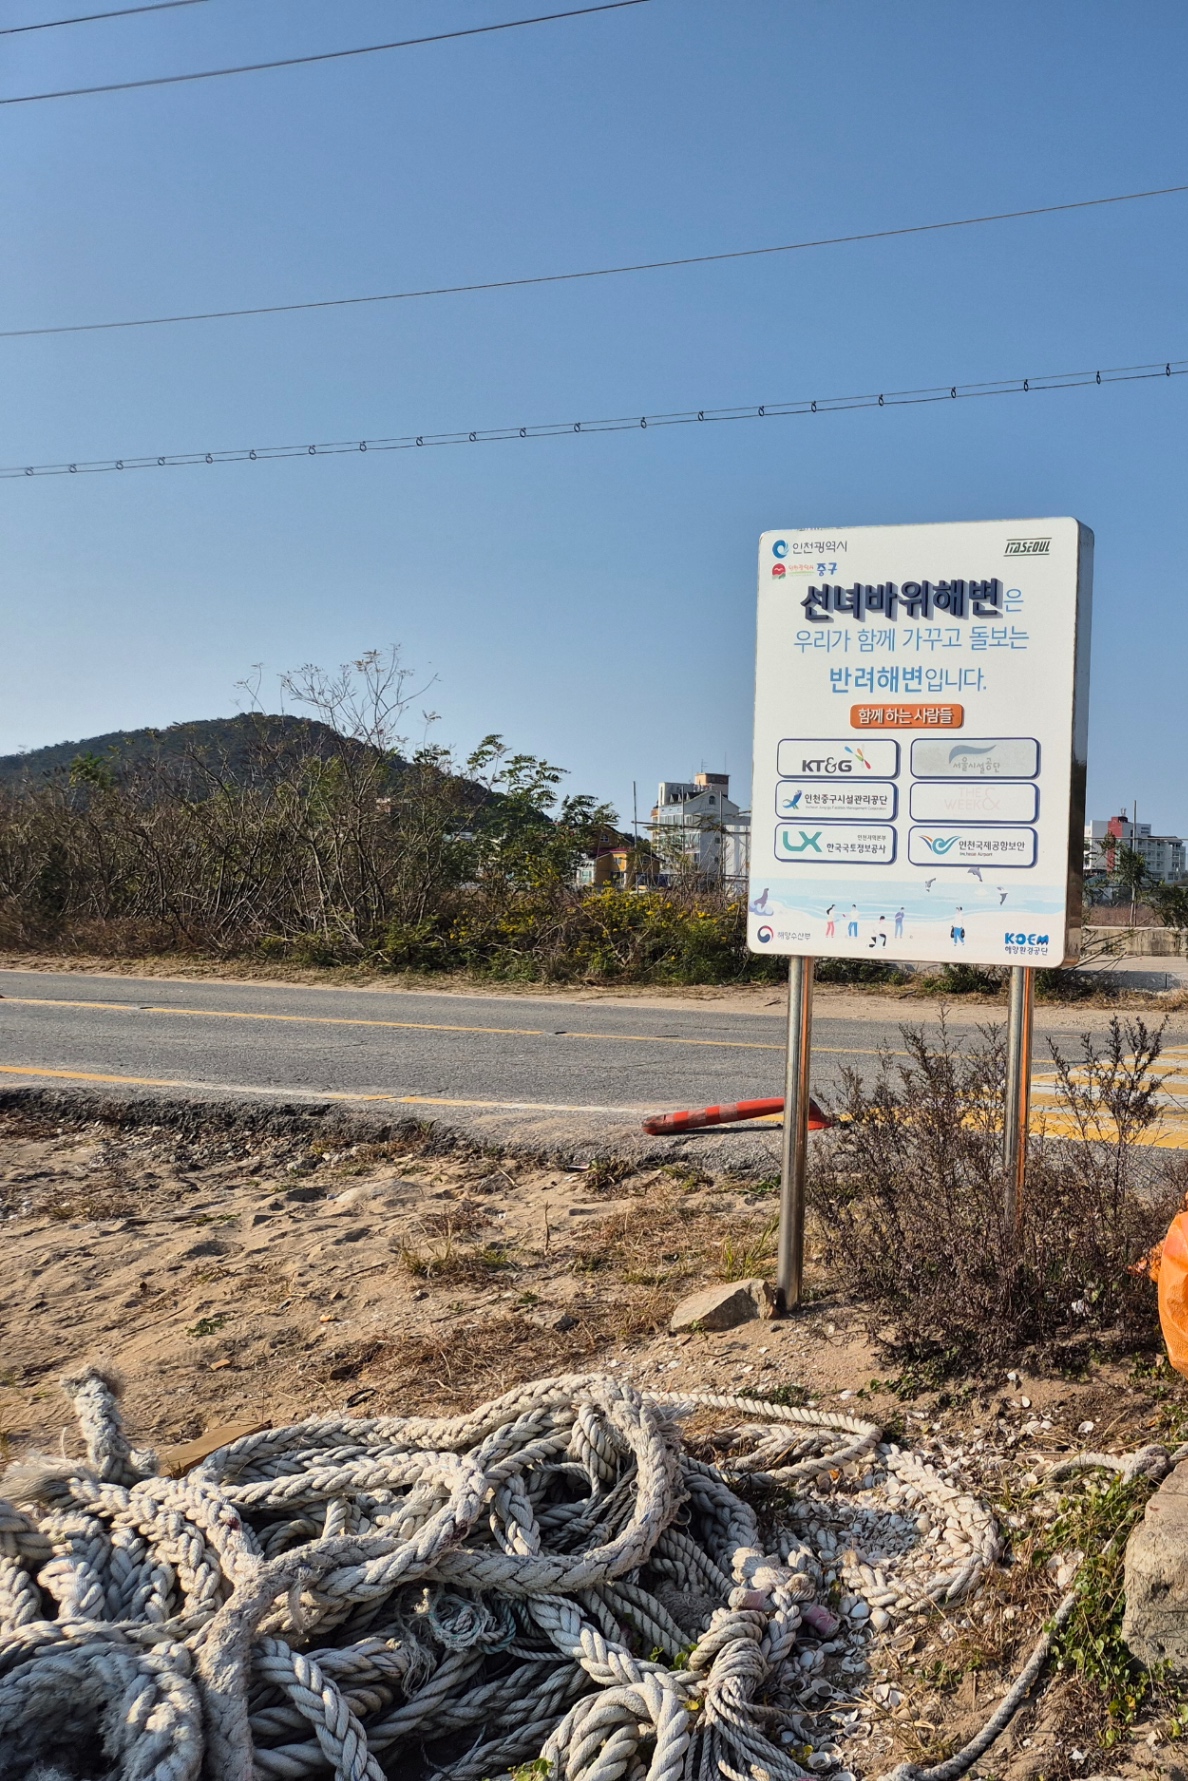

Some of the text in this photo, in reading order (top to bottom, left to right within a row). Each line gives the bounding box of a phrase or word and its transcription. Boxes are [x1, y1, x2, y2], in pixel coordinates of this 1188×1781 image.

[792, 540, 848, 555] 인천광역시
[817, 562, 838, 577] 중구
[800, 577, 1024, 623] 선녀바위해변은
[793, 625, 1030, 654] 우리가 함께 가꾸고 돌보는
[829, 665, 987, 693] 반려해변입니다.
[857, 707, 955, 724] 함께 하는 사람들
[802, 757, 852, 774] KT&G
[952, 756, 1001, 774] 서울시설공단
[804, 794, 888, 806] 인천중구시설관리공단
[782, 830, 823, 853] LX
[826, 843, 886, 854] 한국국토정보공사
[958, 840, 1025, 852] 인천국제공항보안
[777, 931, 811, 941] 해양수산부
[1004, 932, 1049, 946] KOEM
[1004, 945, 1048, 956] 해양환경공단
